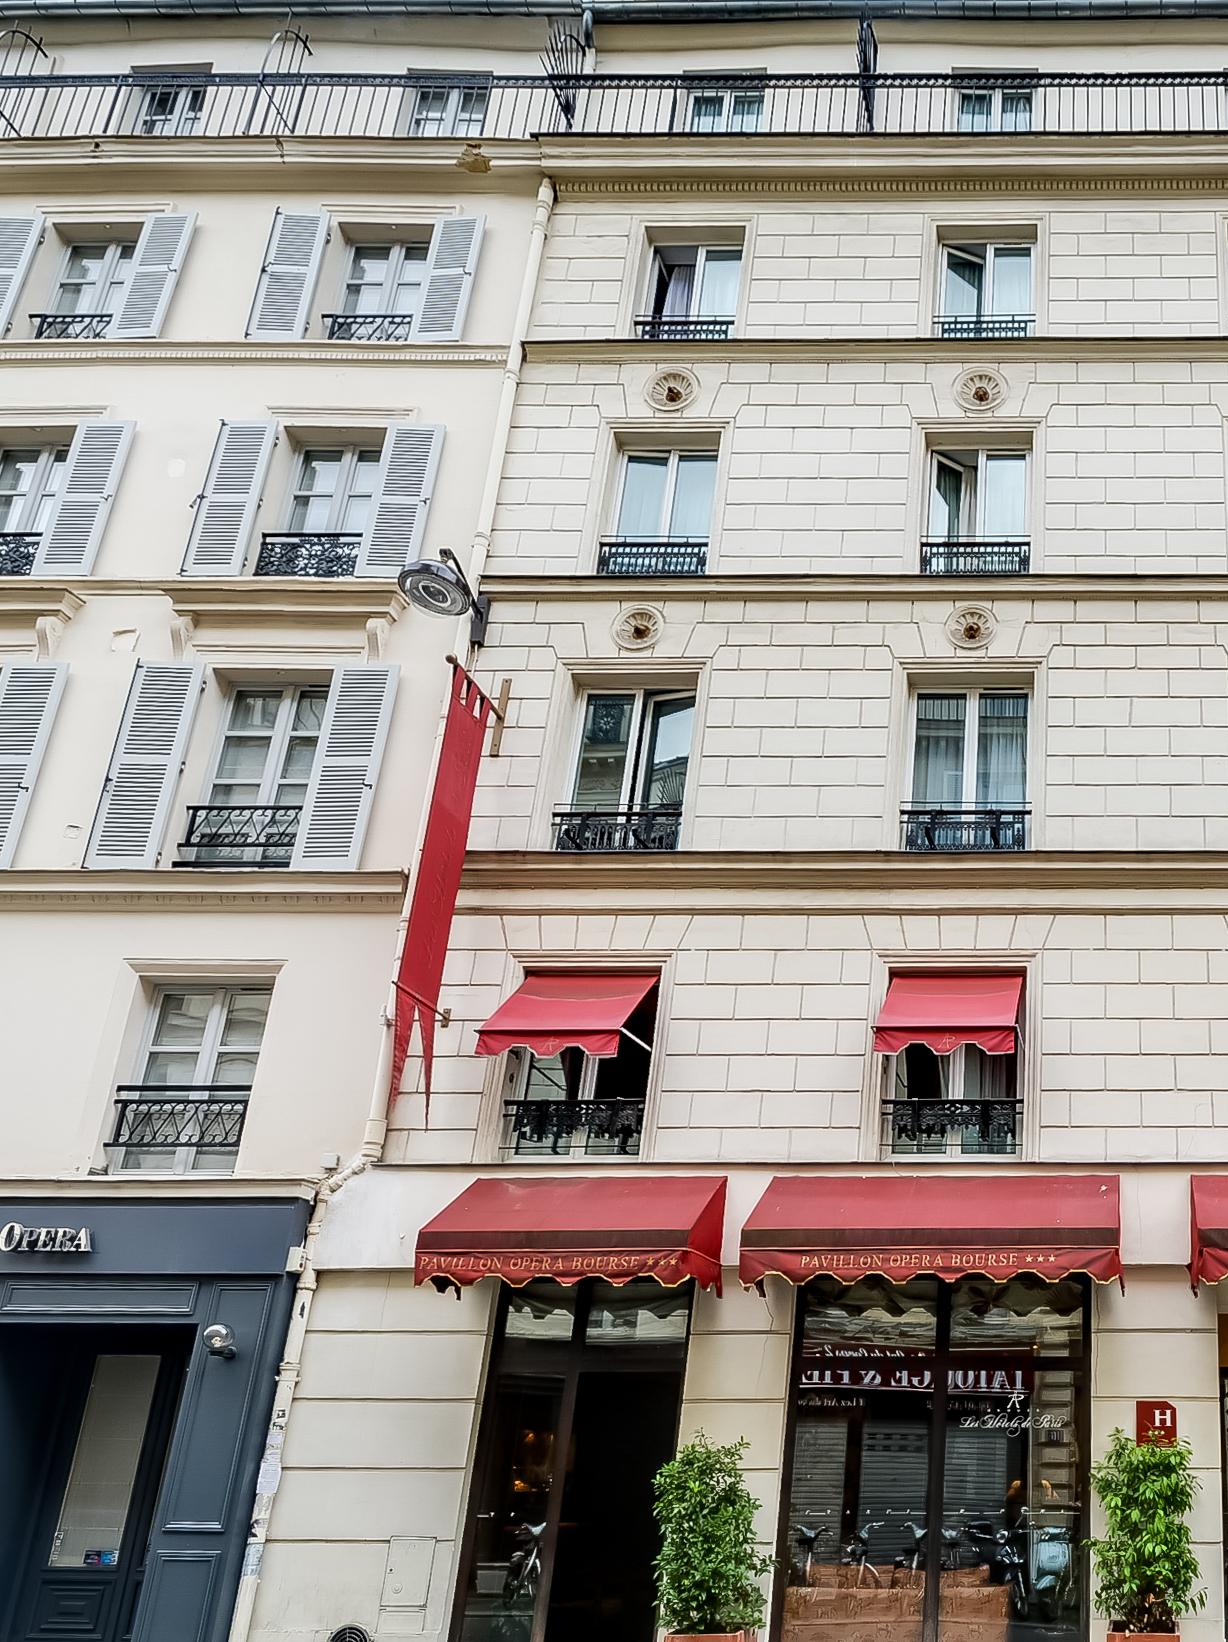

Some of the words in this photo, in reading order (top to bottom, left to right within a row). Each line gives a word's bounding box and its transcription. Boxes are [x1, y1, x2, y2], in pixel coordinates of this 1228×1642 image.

[0, 1222, 92, 1252] OPERA
[419, 1256, 503, 1271] PAVILLON
[510, 1256, 564, 1271] OPERA
[571, 1255, 640, 1271] BOURSE
[800, 1254, 883, 1269] PAVILLON
[890, 1254, 944, 1268] OPERA
[951, 1253, 1018, 1267] BOURSE
[1153, 1409, 1173, 1427] H
